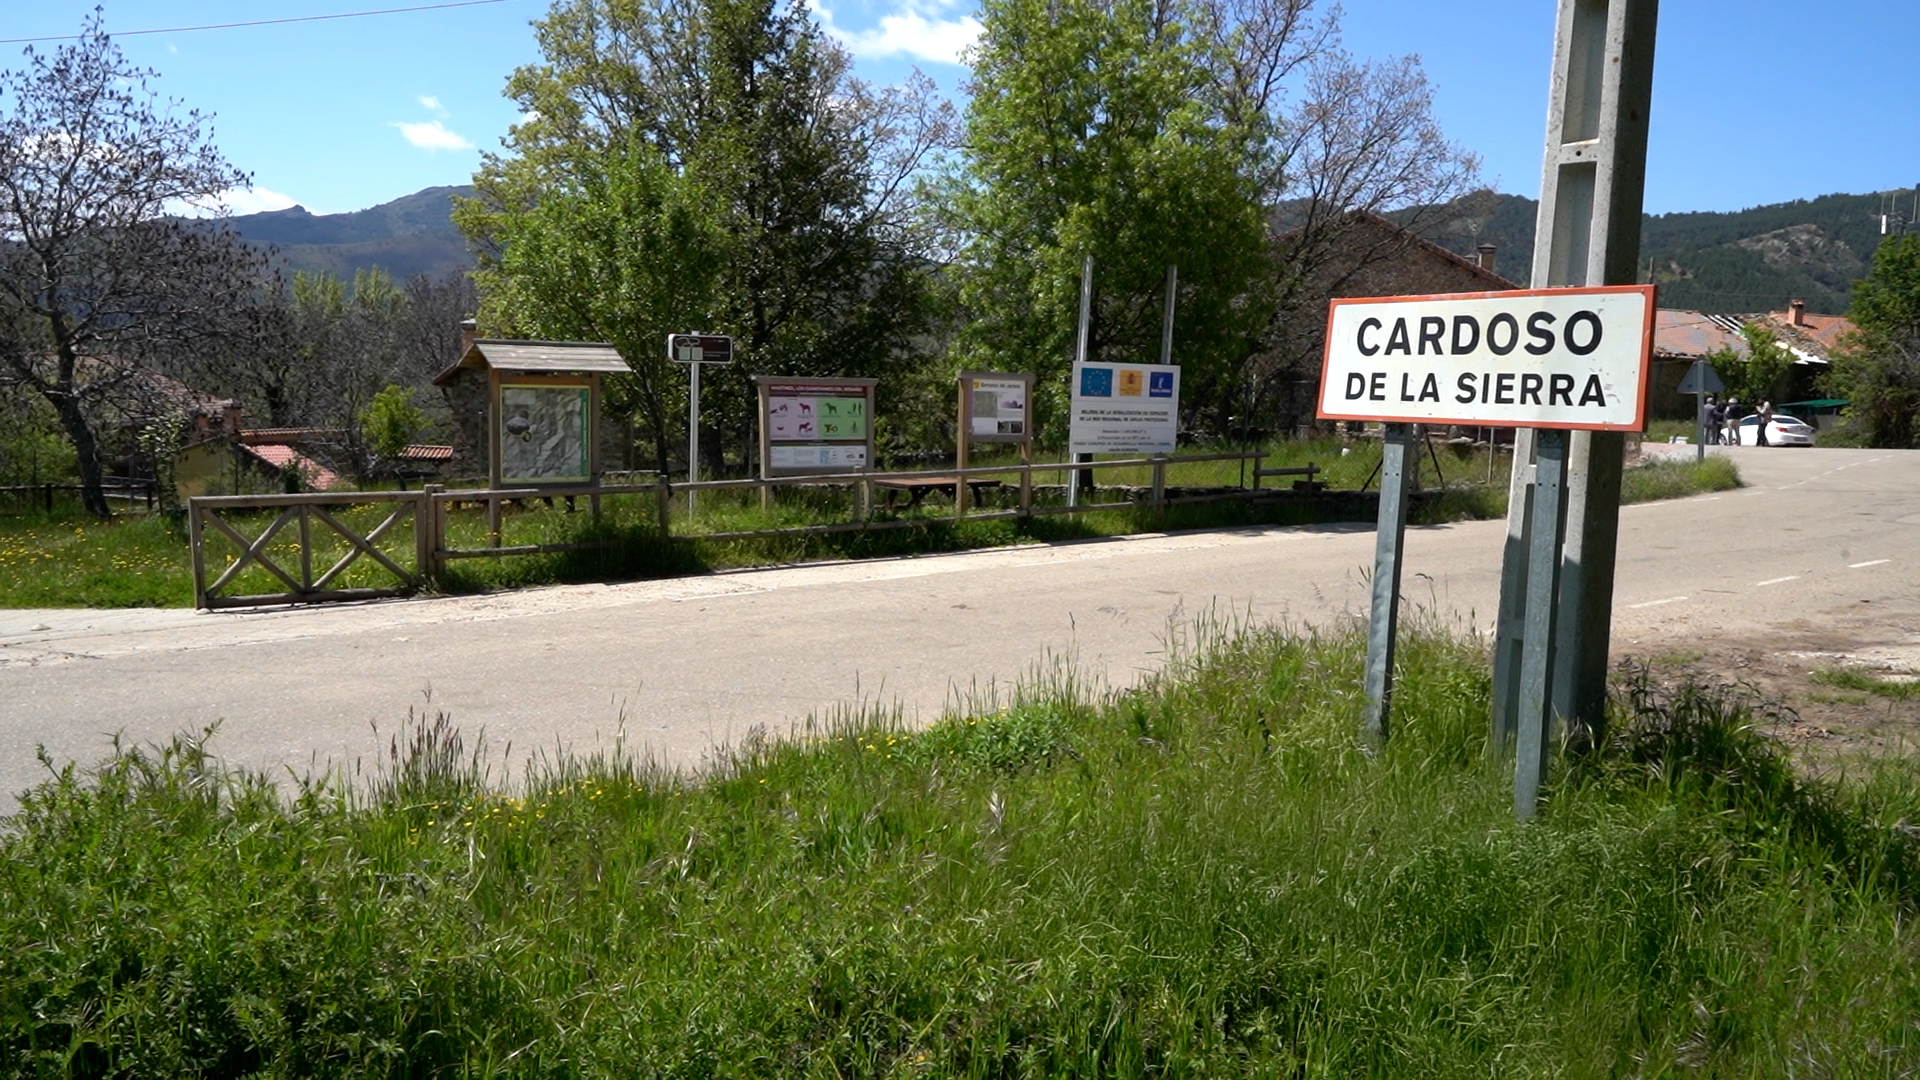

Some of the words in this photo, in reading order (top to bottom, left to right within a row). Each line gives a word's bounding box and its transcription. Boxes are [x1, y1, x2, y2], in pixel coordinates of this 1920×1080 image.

[1356, 309, 1604, 357] CARDOSO
[1345, 372, 1387, 401] DE
[1400, 372, 1440, 403] LA
[1454, 372, 1607, 407] SIERRA
